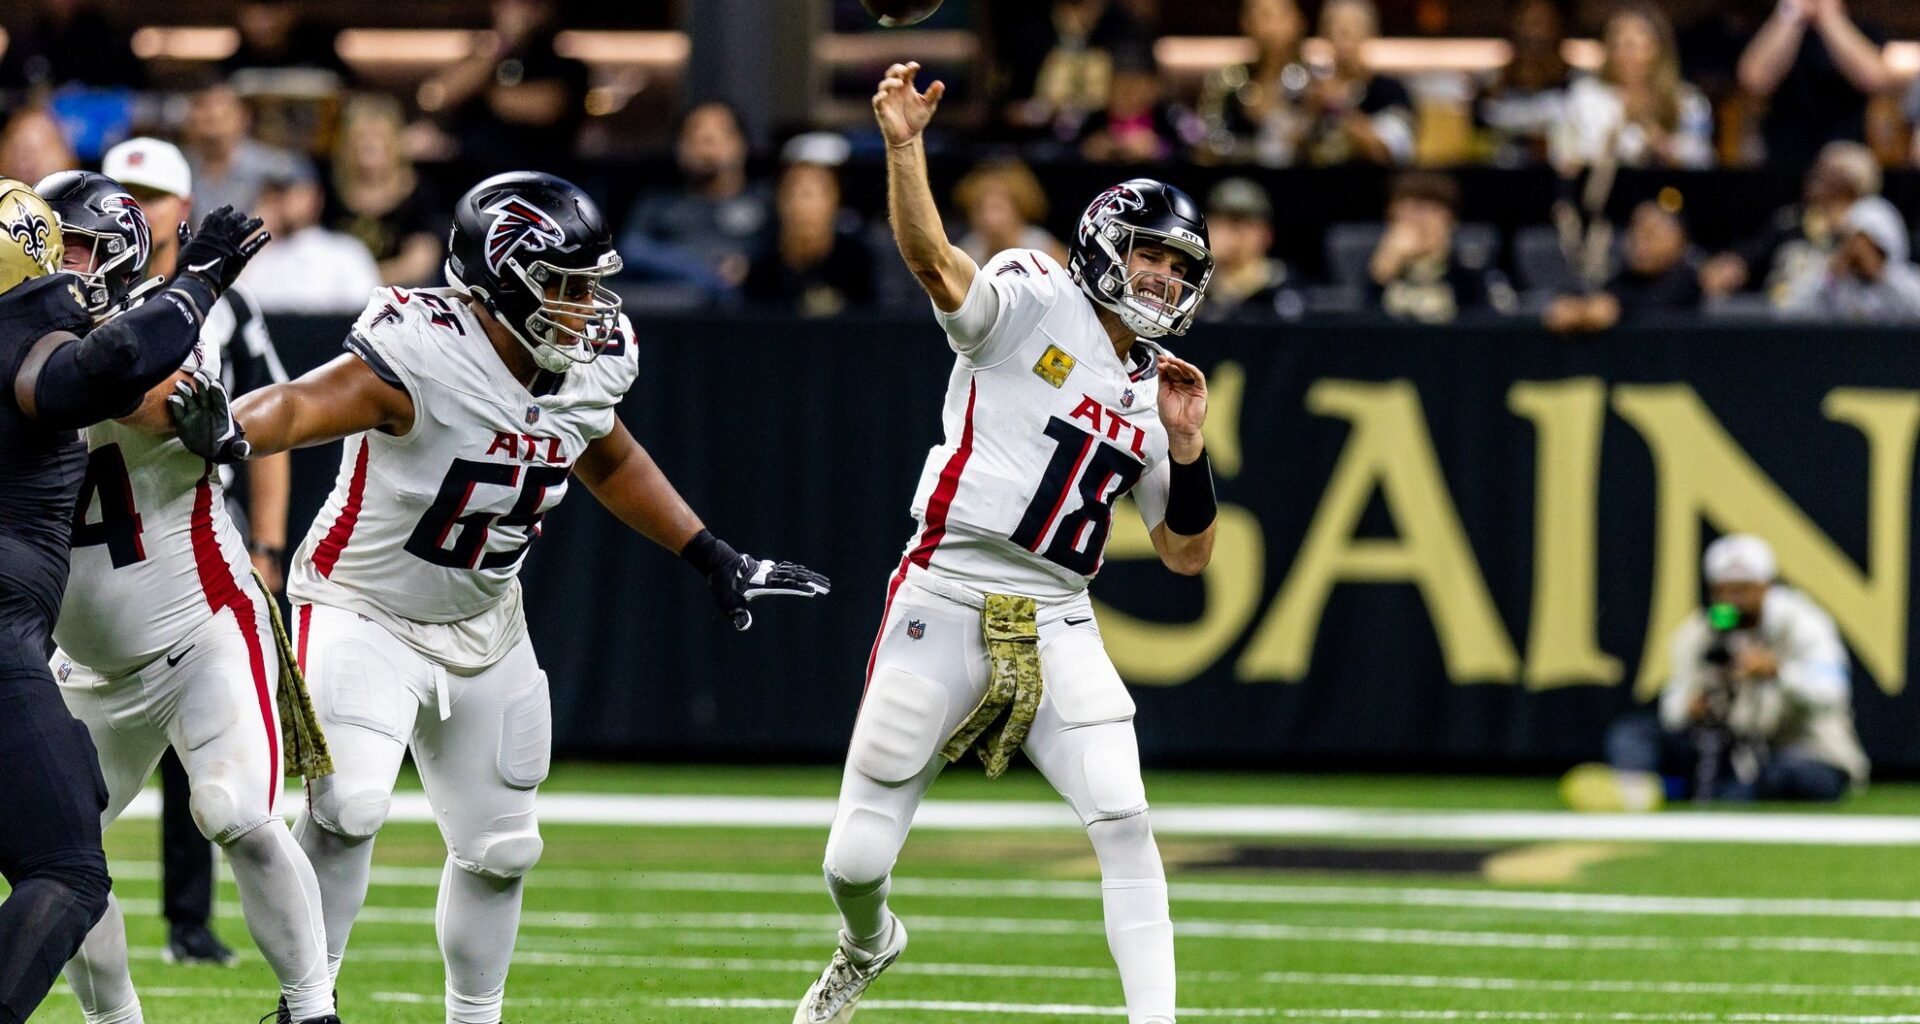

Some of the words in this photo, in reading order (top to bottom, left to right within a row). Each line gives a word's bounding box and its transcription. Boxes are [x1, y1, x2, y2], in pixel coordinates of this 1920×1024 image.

[1042, 348, 1073, 378] C
[485, 431, 568, 463] ATL
[1069, 393, 1146, 460] ATL
[403, 457, 573, 571] 65
[1008, 415, 1147, 577] 18
